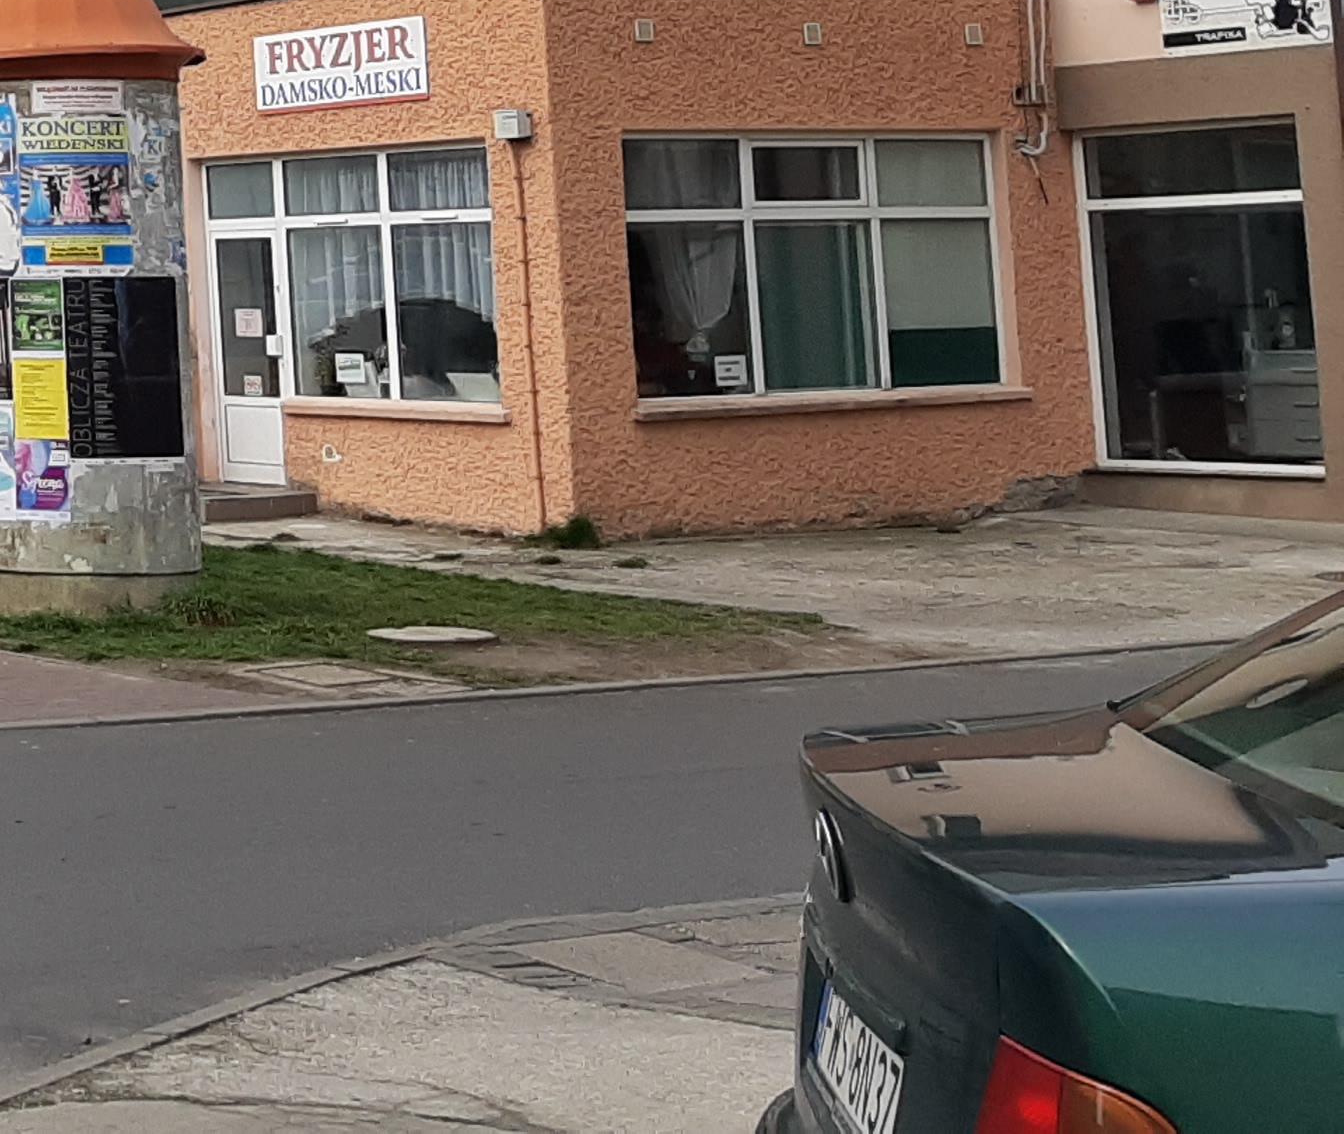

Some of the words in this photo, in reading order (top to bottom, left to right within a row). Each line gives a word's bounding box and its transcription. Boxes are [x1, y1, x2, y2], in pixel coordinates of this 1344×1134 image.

[265, 25, 414, 74] FRYZJER
[21, 120, 125, 136] KONCERT
[21, 136, 124, 151] WIEDEŃSKI
[65, 277, 89, 359] TEATRU
